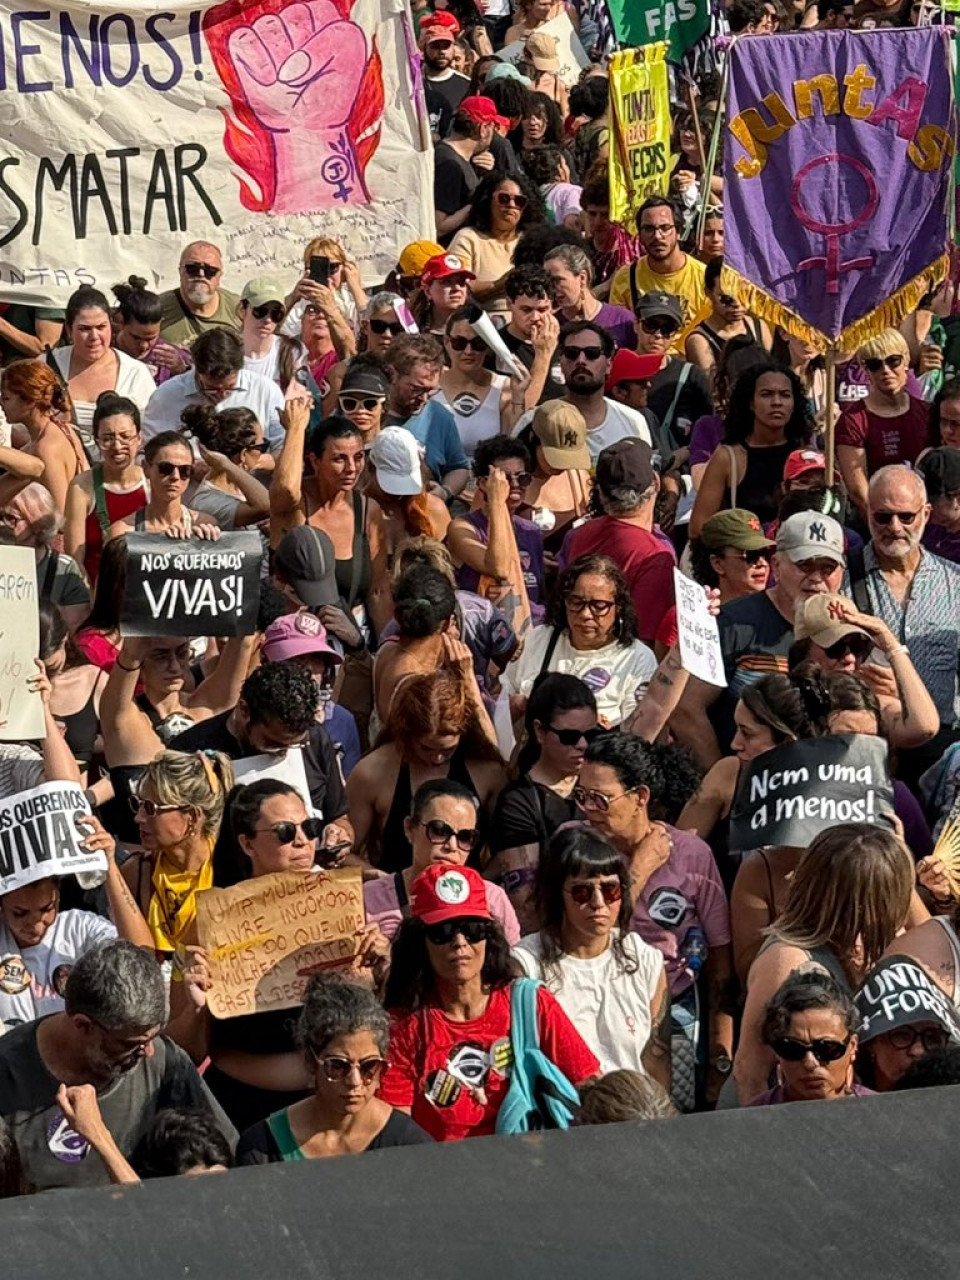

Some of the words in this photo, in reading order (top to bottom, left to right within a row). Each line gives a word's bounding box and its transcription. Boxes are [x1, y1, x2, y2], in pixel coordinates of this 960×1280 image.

[32, 144, 224, 246] MATAR
[140, 551, 171, 572] NOS
[173, 550, 246, 571] QUEREMOS
[141, 574, 244, 619] VIVAS!
[749, 767, 810, 803] Nem
[818, 764, 873, 785] uma
[13, 789, 86, 826] QUEREMOS
[750, 804, 768, 830] a
[775, 789, 875, 824] menos!
[214, 915, 274, 950] LIVRE
[293, 920, 334, 947] QUE
